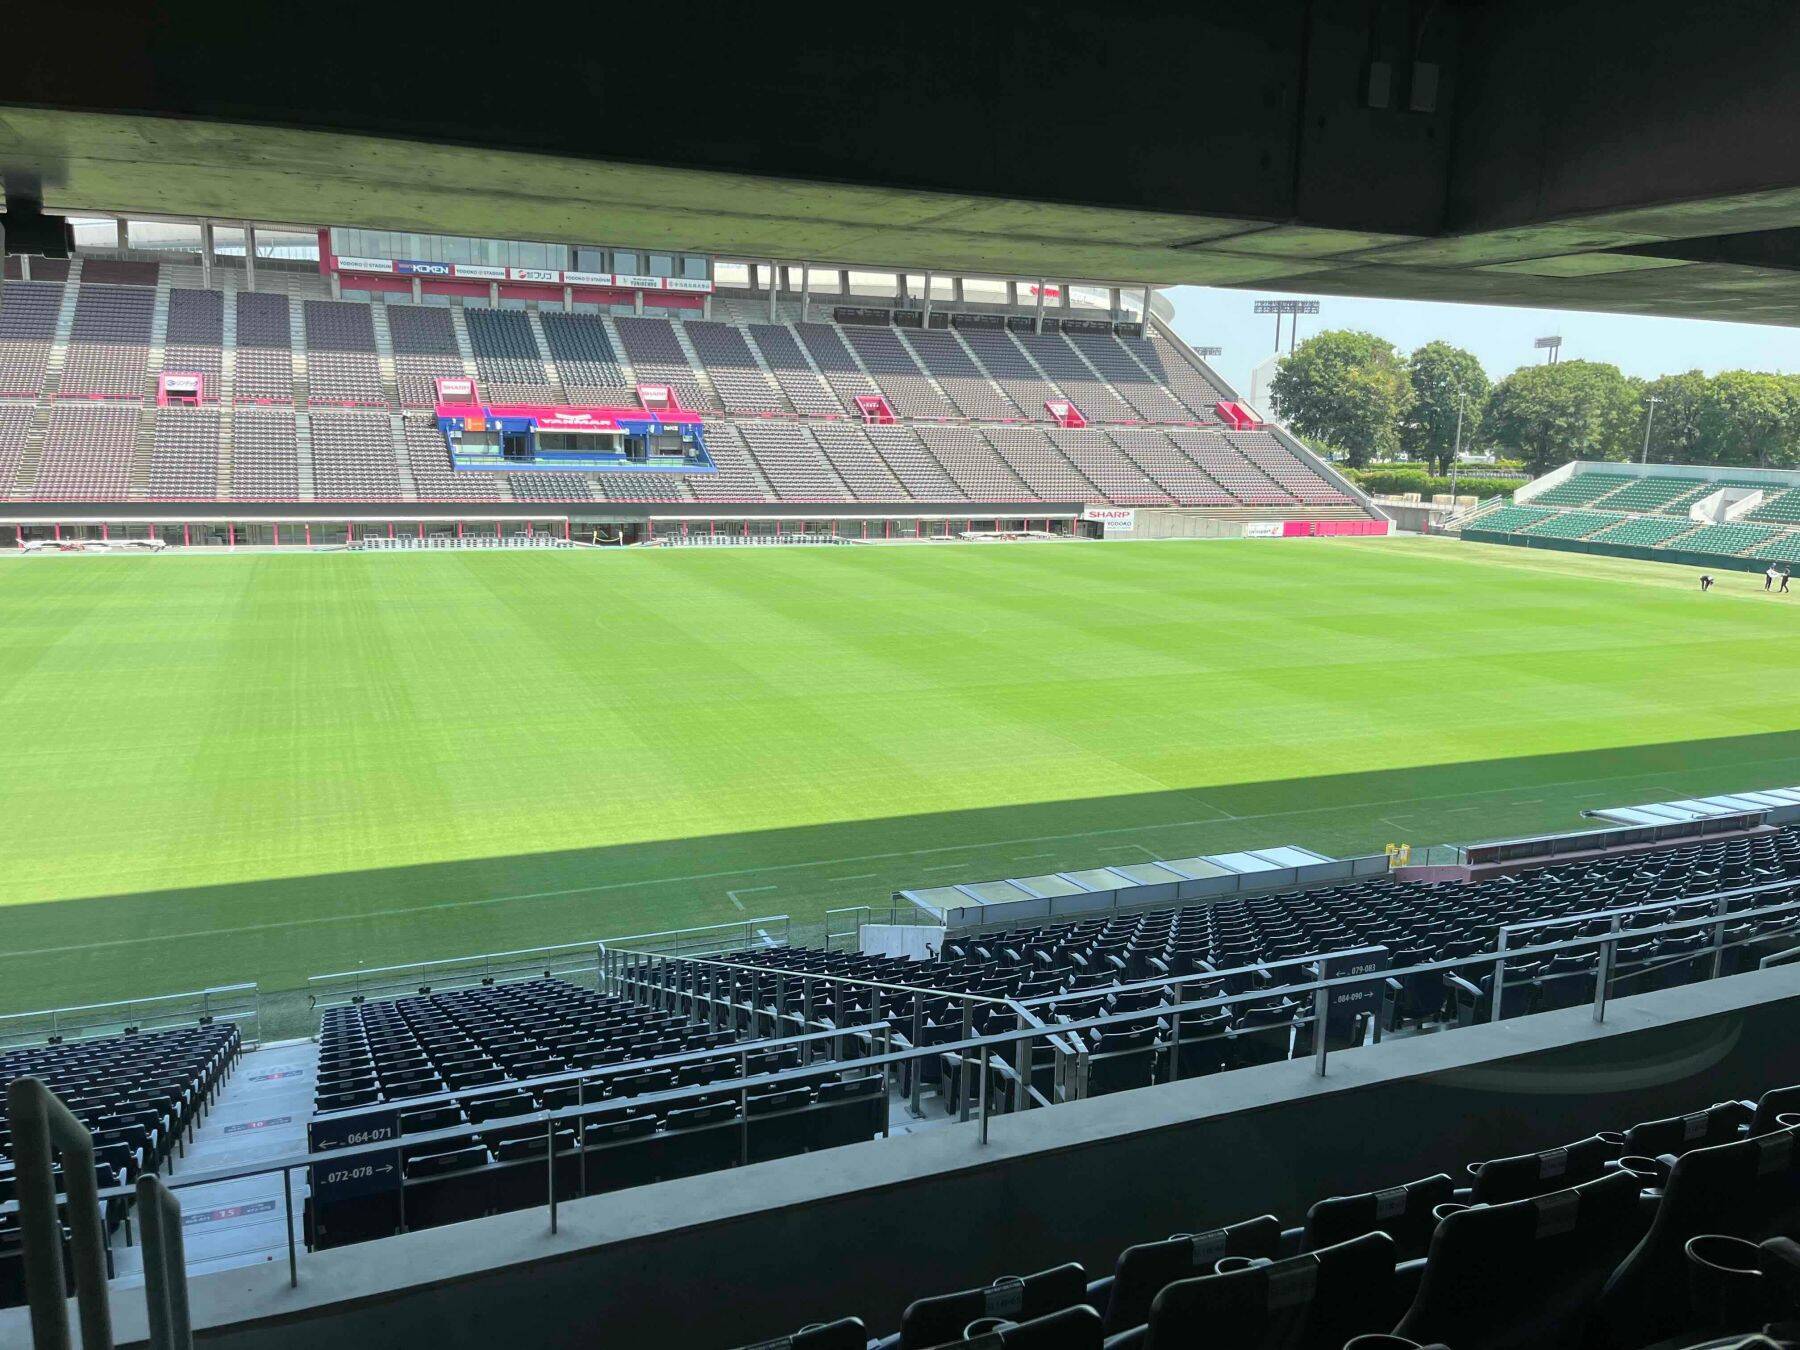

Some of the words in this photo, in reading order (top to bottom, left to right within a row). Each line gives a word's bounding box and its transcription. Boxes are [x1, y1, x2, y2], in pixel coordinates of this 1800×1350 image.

[413, 264, 449, 274] KOKEN
[1088, 511, 1130, 519] SHARP
[1351, 964, 1375, 975] 079-083
[1337, 992, 1362, 1002] 084-090
[347, 1127, 392, 1145] 064-071
[328, 1166, 373, 1183] 072-078
